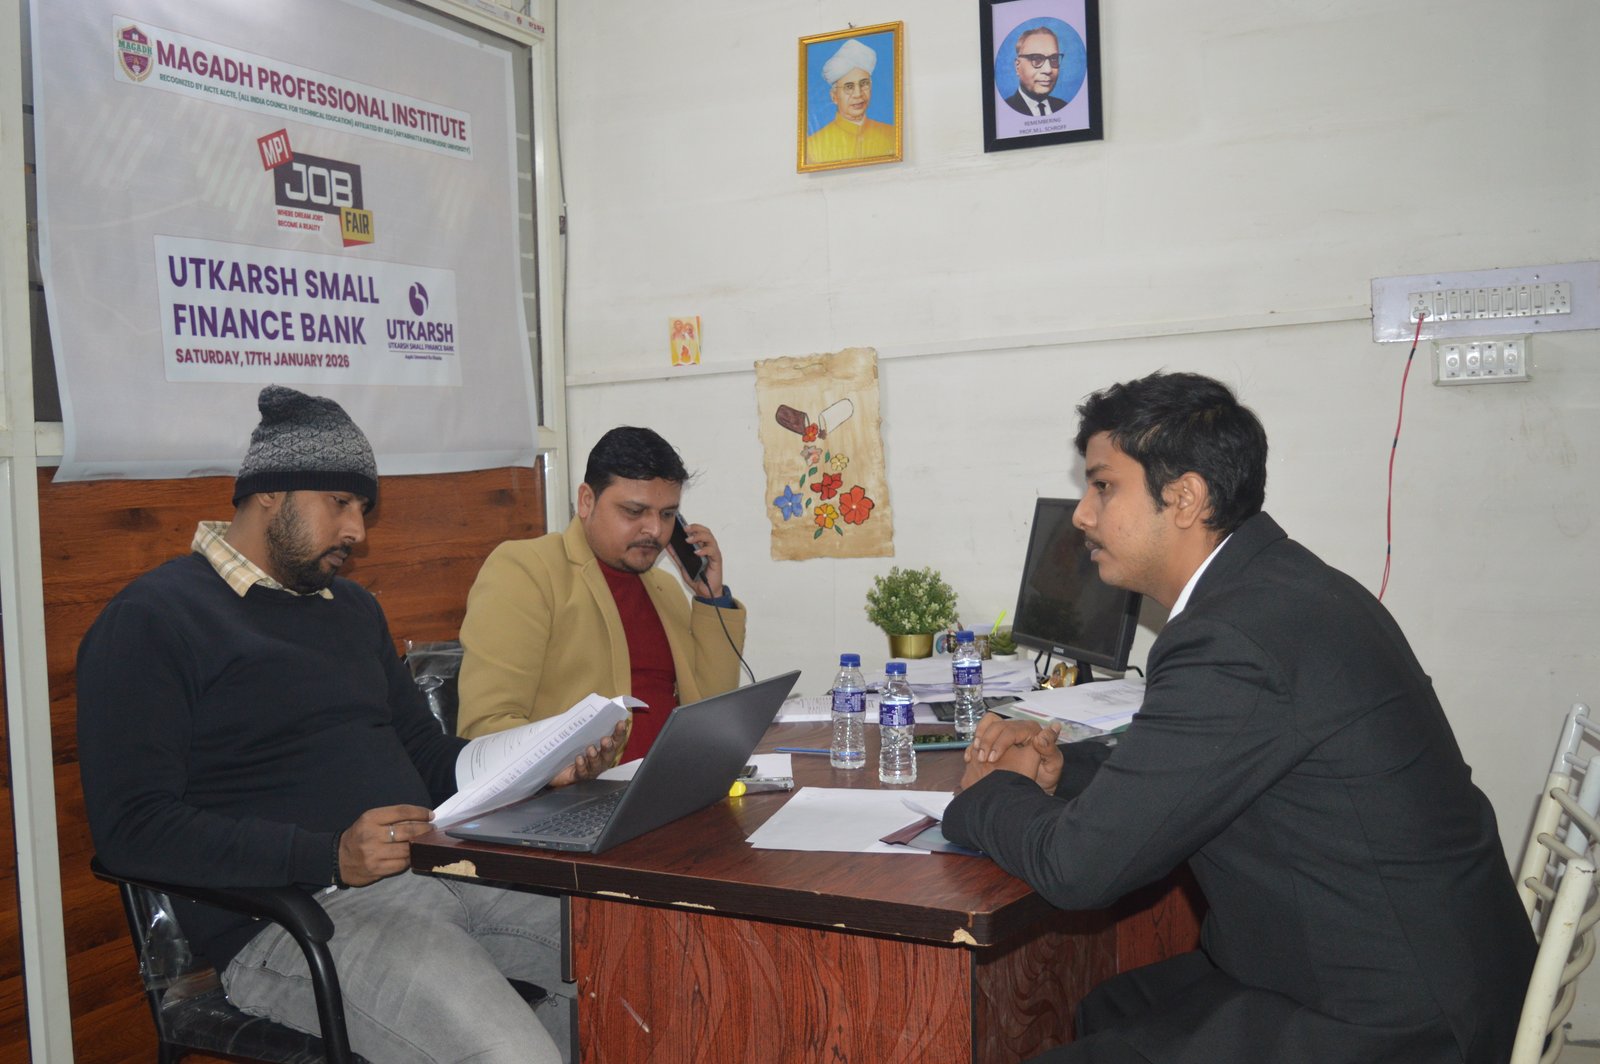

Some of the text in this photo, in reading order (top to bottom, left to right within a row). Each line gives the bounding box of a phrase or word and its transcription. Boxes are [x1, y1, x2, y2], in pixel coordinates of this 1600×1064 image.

[118, 40, 152, 56] MAGADH
[156, 40, 466, 141] MAGADH PROFESSIONAL INSTITUTE
[159, 73, 194, 89] RECOGNIZED
[195, 82, 203, 91] BY
[250, 96, 265, 105] INDIA
[266, 99, 289, 111] COUNCIL
[288, 105, 298, 113] FOR
[298, 107, 325, 120] TECHNICAL
[262, 136, 290, 166] MPI
[285, 163, 353, 208] JOB
[277, 209, 324, 222] WHERE DREAM JOBS
[277, 219, 298, 229] BECOME
[302, 223, 321, 232] REALITY
[345, 211, 370, 235] FAIR
[168, 255, 380, 304] UTKARSH SMALL
[173, 303, 367, 345] FINANCE BANK
[386, 318, 454, 343] UTKARSH
[175, 348, 350, 368] SATURDAY, 17TH JANUARY 2026
[388, 342, 409, 350] UTKARSH
[409, 343, 425, 351] SMALL
